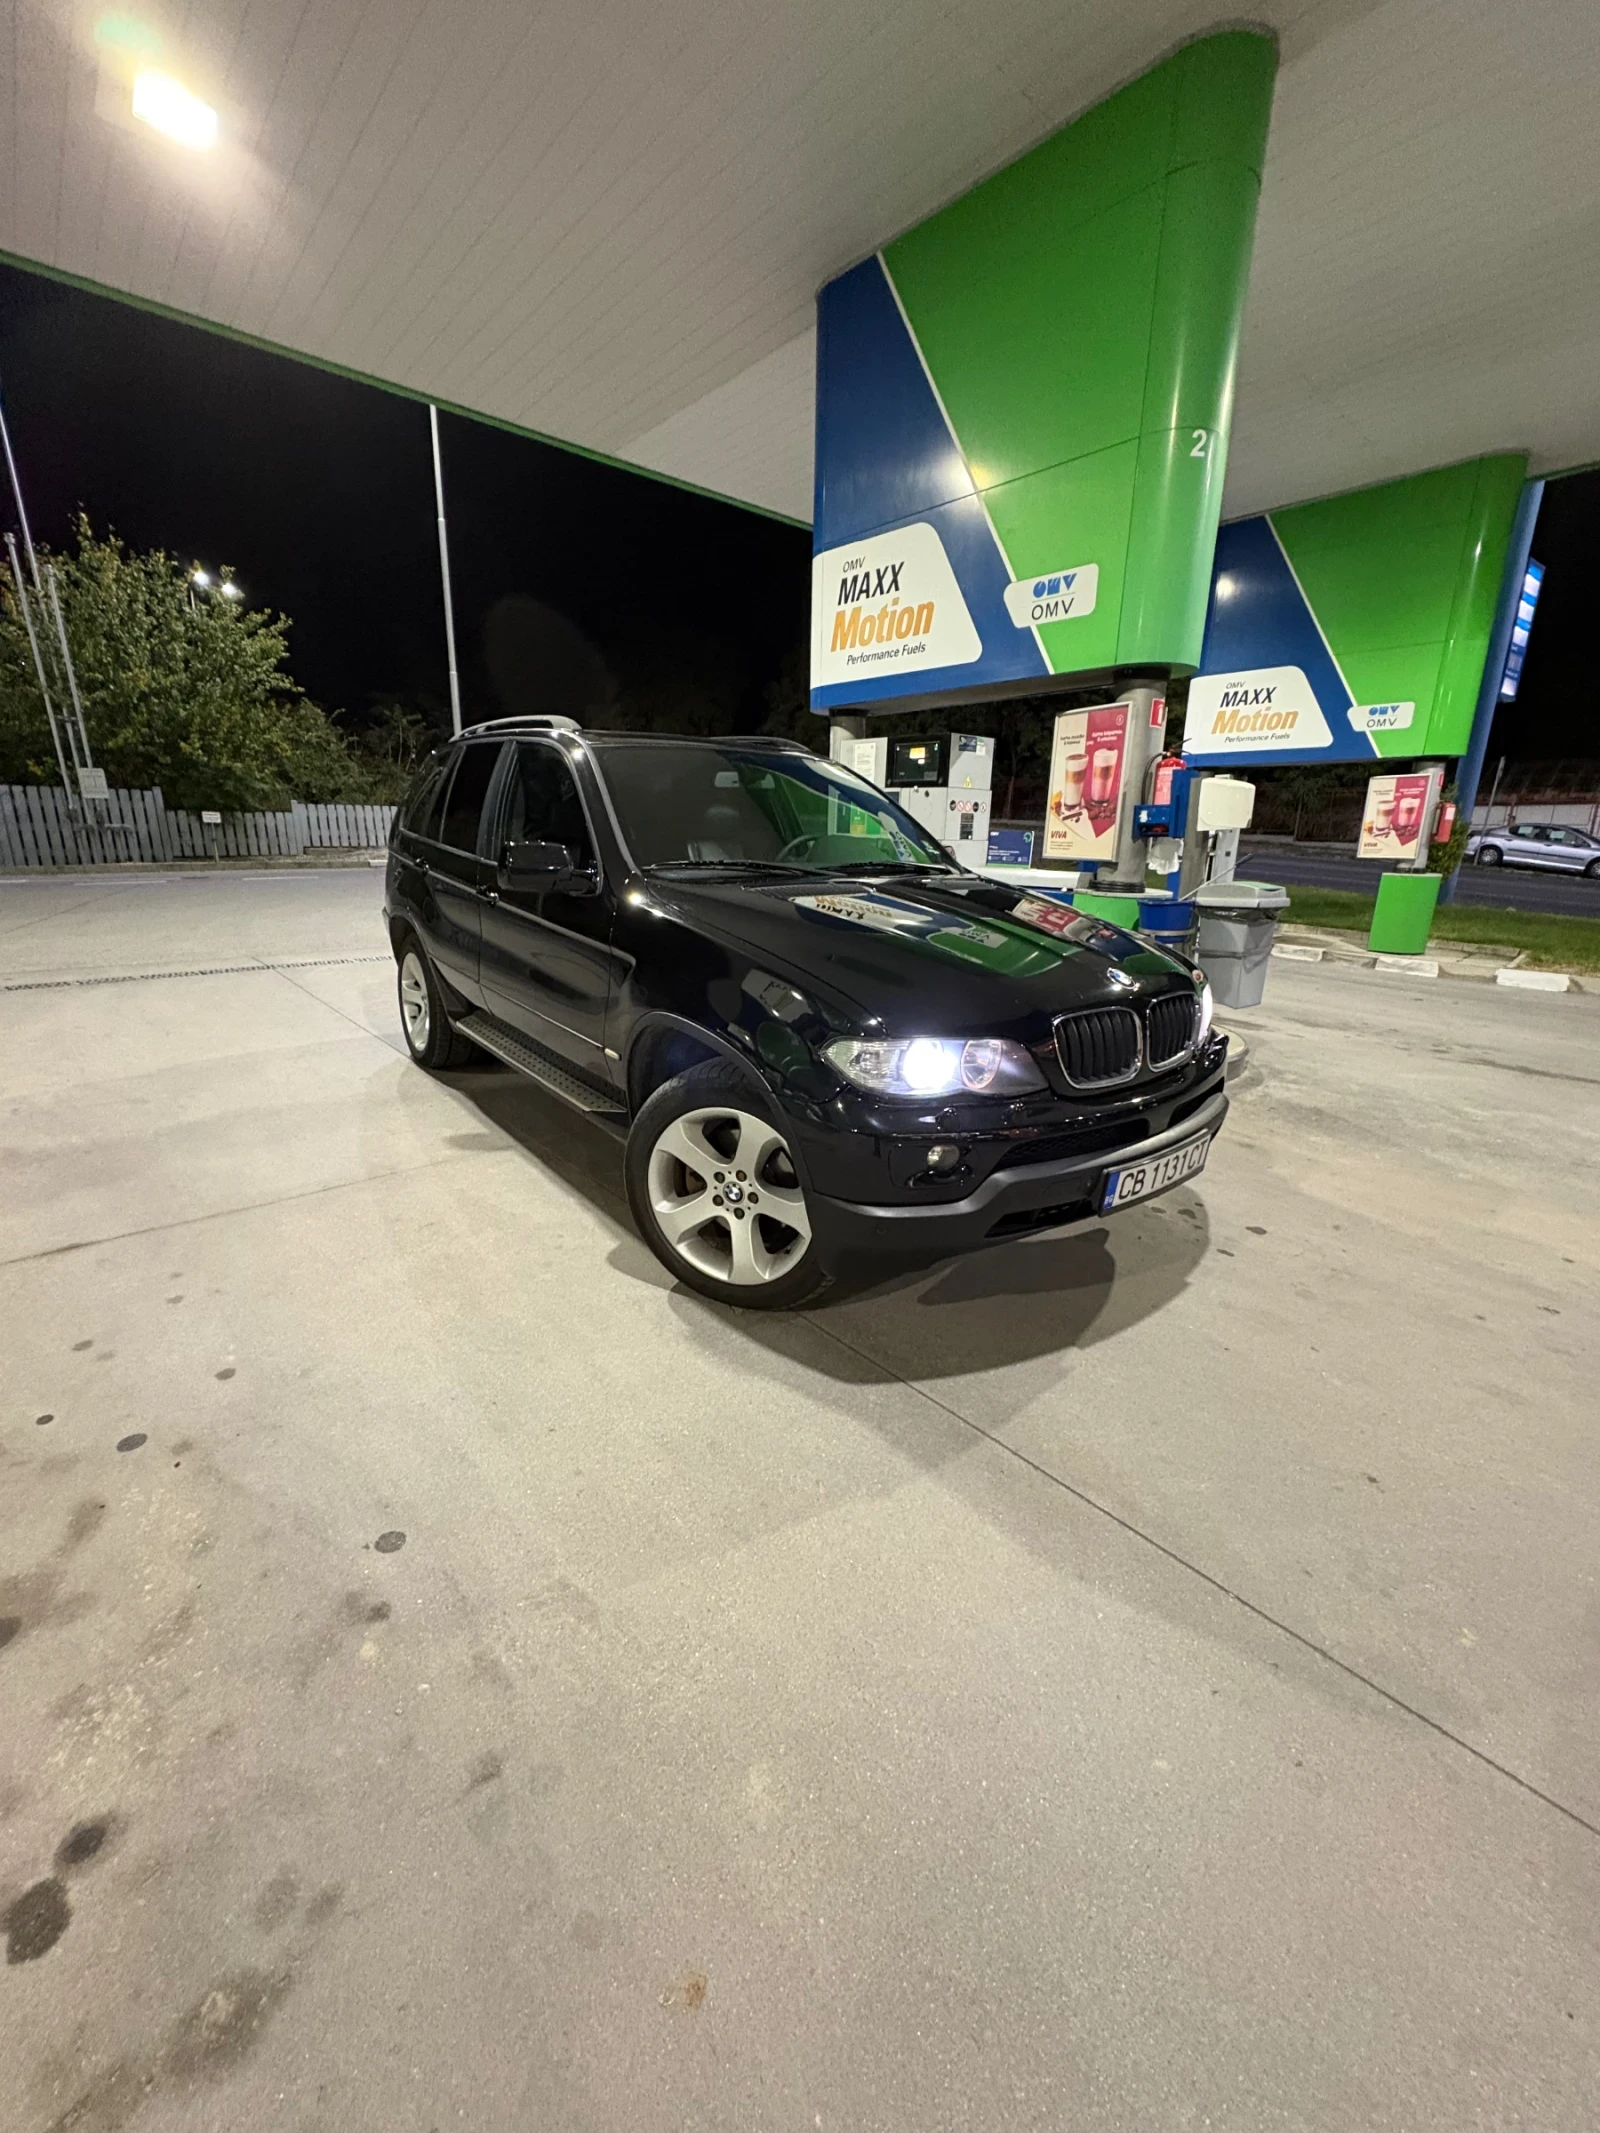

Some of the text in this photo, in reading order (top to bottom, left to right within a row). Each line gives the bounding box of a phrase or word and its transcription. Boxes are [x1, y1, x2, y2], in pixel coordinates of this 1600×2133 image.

[1190, 429, 1207, 457] 2
[843, 556, 866, 573] OMV
[837, 561, 905, 606] MAXX
[1031, 597, 1075, 621] OMV
[830, 596, 935, 653] Motion
[846, 641, 927, 666] Performance Fuels
[1219, 686, 1278, 708] MAXX
[1225, 681, 1246, 690] OMV
[1211, 706, 1299, 735] Motion
[1366, 717, 1398, 729] OMV
[1224, 732, 1291, 743] Performance Fuels
[1050, 830, 1067, 839] VIVA
[1118, 1168, 1146, 1200] CB
